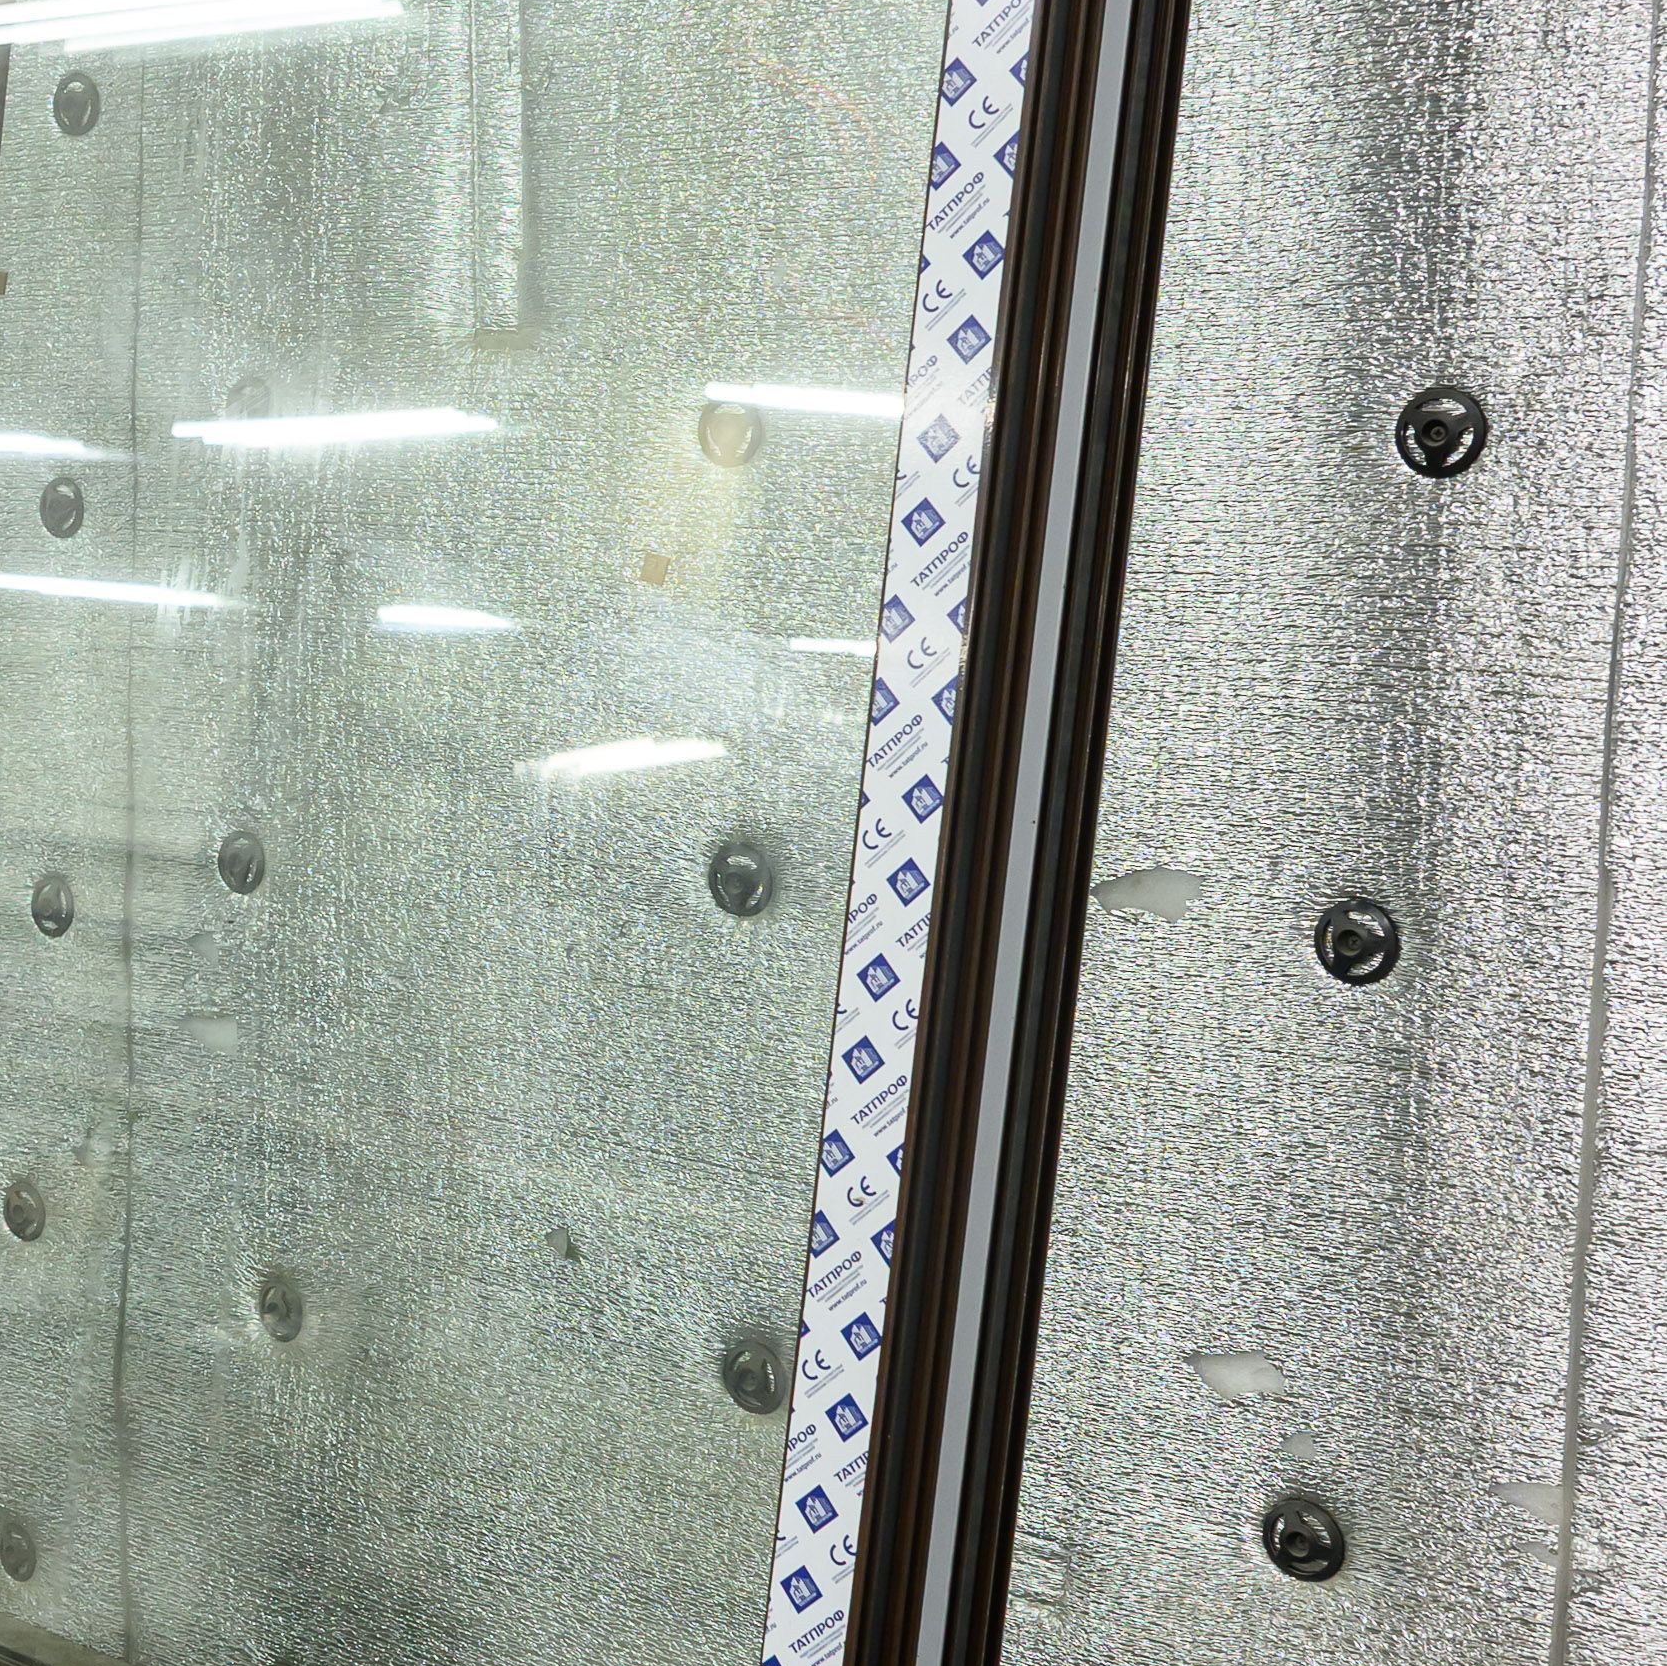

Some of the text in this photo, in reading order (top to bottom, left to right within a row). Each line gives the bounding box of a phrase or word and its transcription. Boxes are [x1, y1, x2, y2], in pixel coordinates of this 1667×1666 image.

[926, 171, 984, 231] ТАТПРОФ
[910, 531, 968, 587] ТАТПРОФ
[866, 714, 922, 769] ТАТПРОФ
[850, 1075, 908, 1125] ТАТПРОФ
[807, 1250, 862, 1299] ТАТПРОФ
[789, 1609, 844, 1654] ТАТПРОФ
